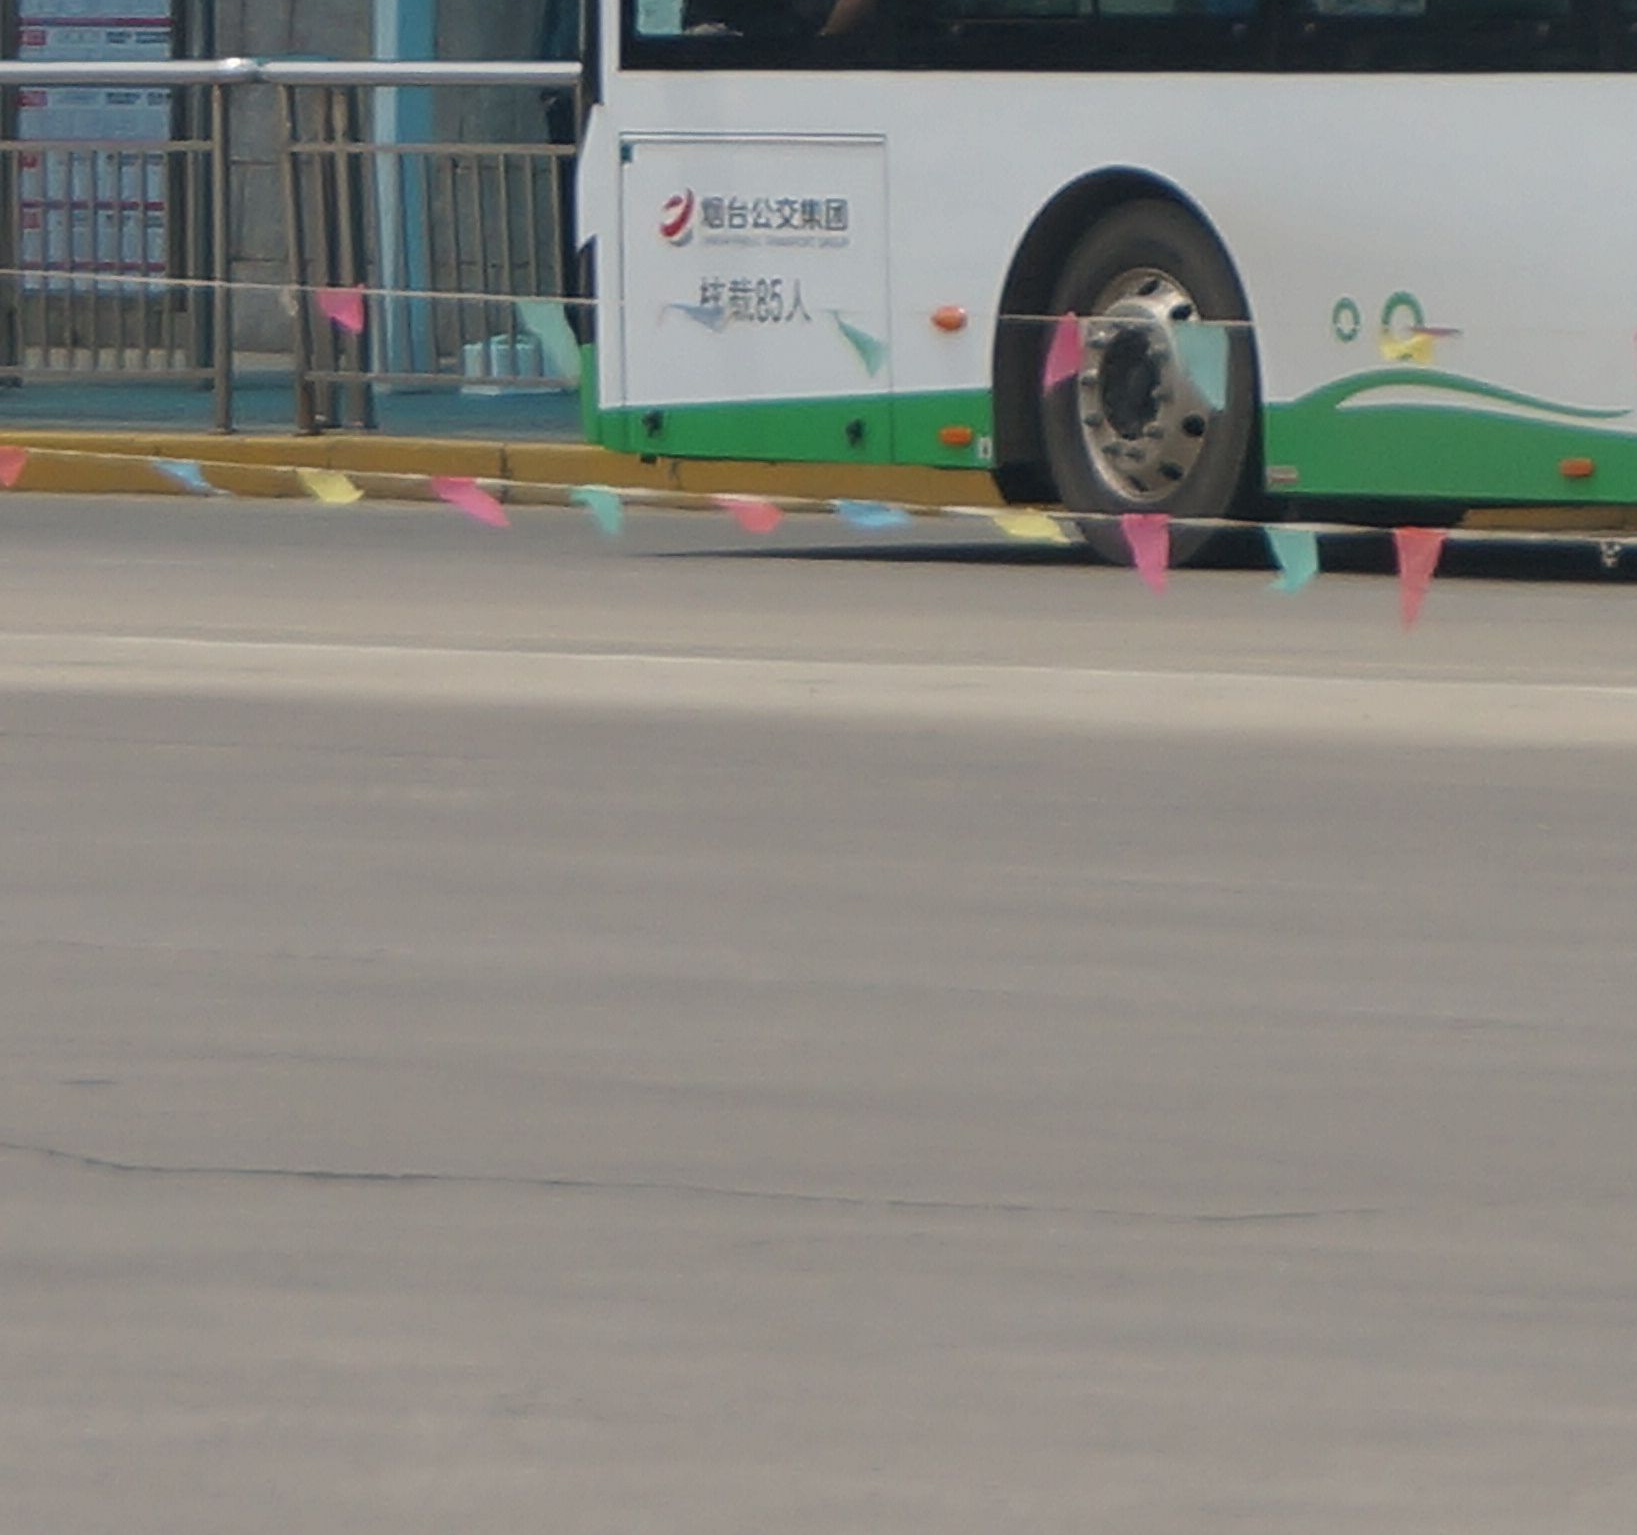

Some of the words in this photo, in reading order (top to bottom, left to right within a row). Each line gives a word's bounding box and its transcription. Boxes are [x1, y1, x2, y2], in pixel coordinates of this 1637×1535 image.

[701, 195, 848, 231] 烟台公交集团
